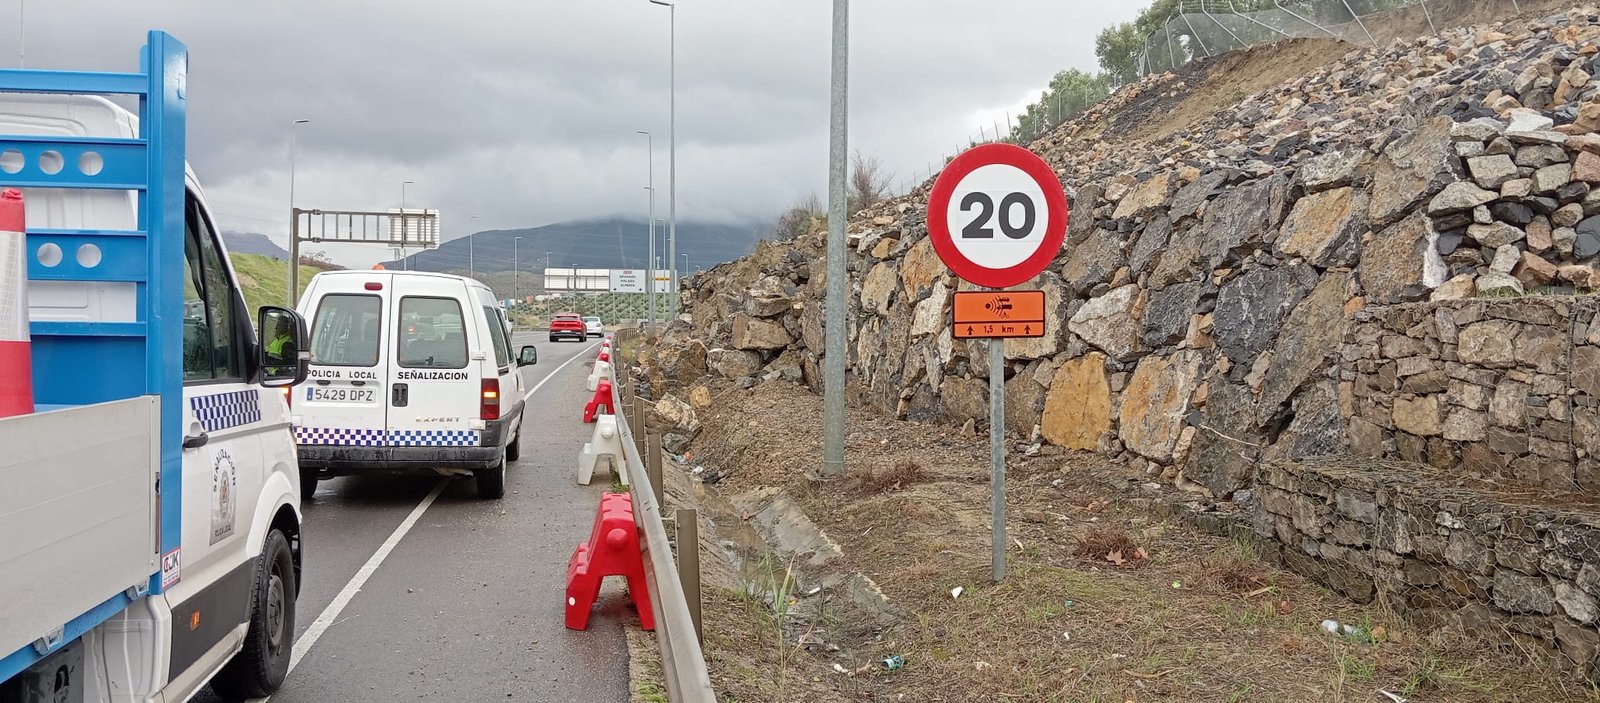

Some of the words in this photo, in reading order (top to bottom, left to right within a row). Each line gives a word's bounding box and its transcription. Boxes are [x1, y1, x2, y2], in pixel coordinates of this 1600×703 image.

[959, 191, 1036, 240] 20
[1002, 325, 1014, 333] km
[307, 369, 341, 378] POLICIA
[349, 371, 377, 380] LOCAL
[397, 369, 469, 380] SEÑALIZACION
[315, 389, 346, 400] 5429
[350, 390, 374, 402] DPZ
